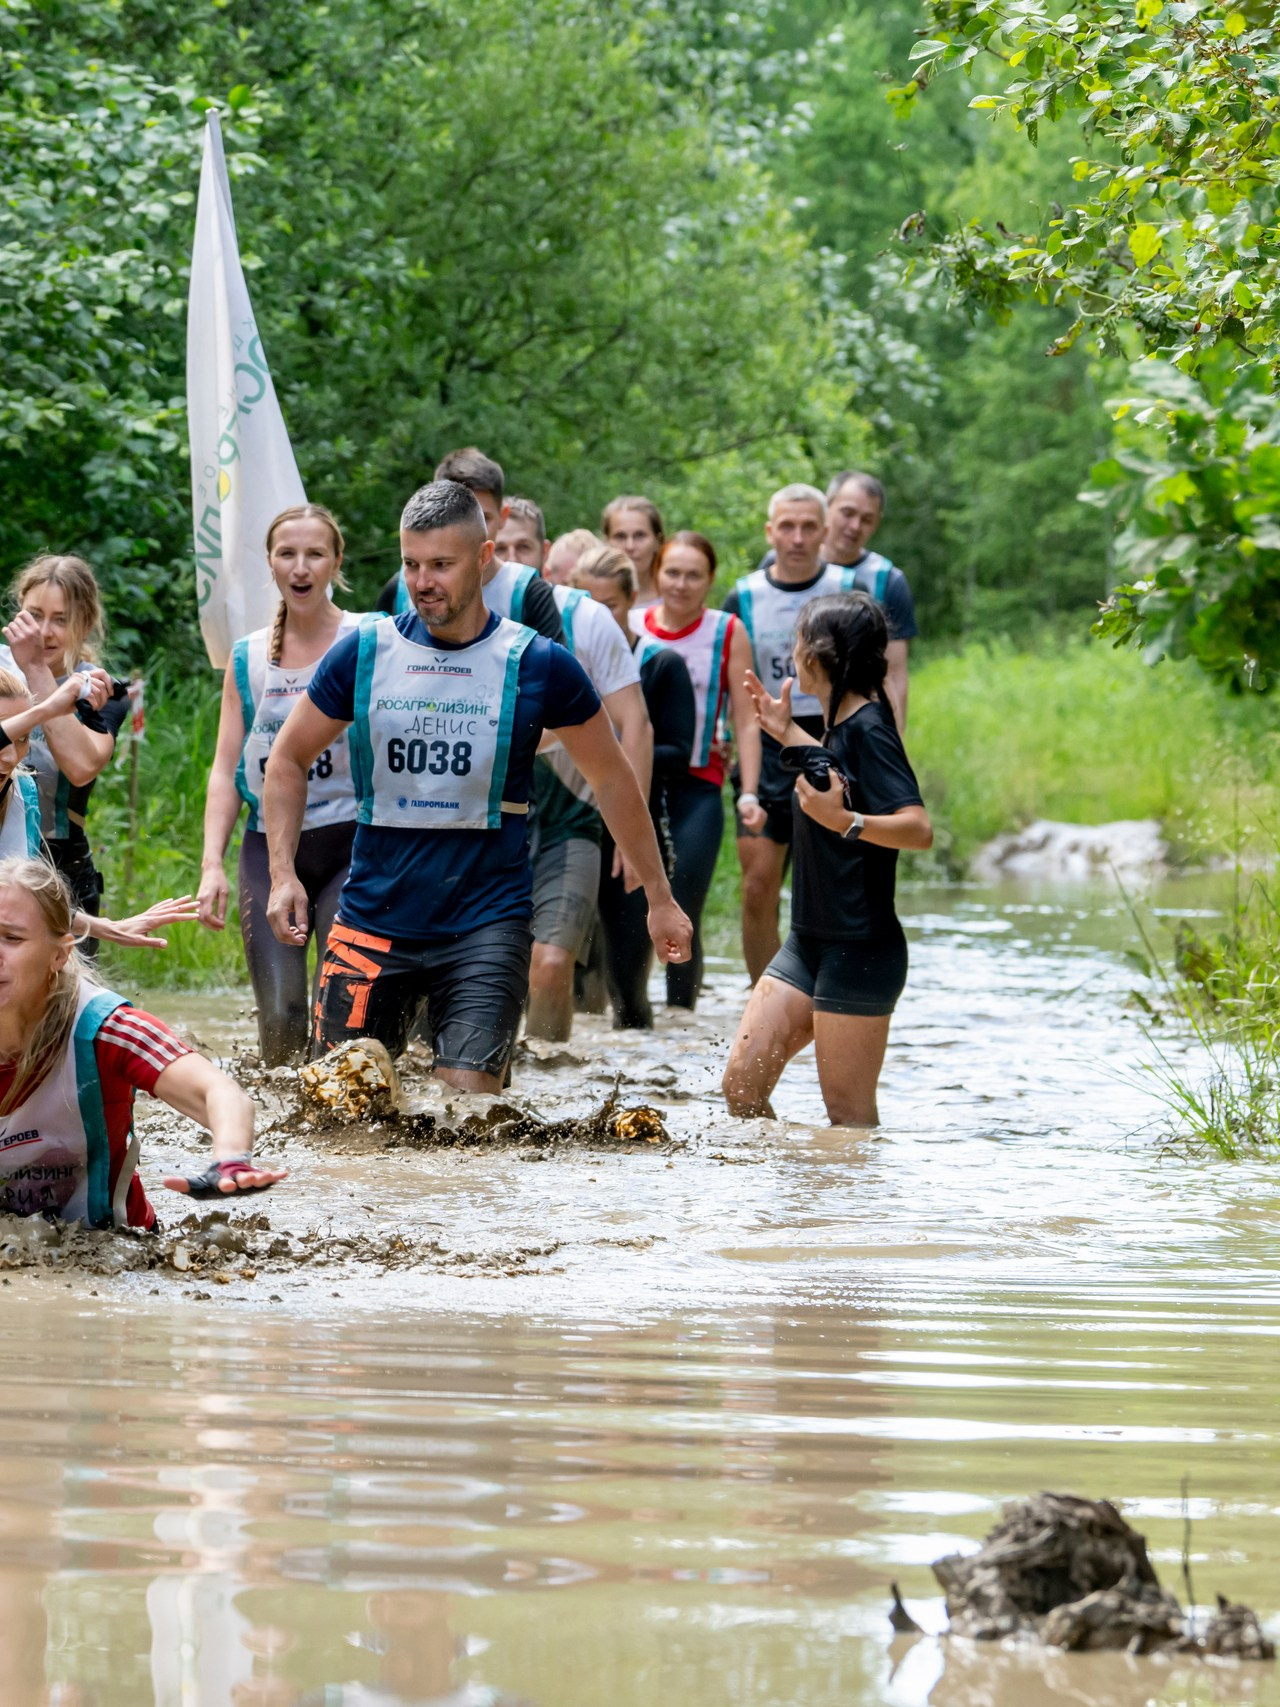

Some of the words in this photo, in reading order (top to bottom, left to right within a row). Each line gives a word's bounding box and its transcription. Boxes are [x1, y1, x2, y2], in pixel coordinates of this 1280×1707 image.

[438, 665, 472, 674] ГЕРОЕВ
[376, 699, 492, 715] РОСАГРОЛИЗИНГ
[404, 715, 477, 735] ДЕНИС
[387, 737, 472, 776] 6038
[410, 799, 460, 809] ГАЗПРОМБАНК
